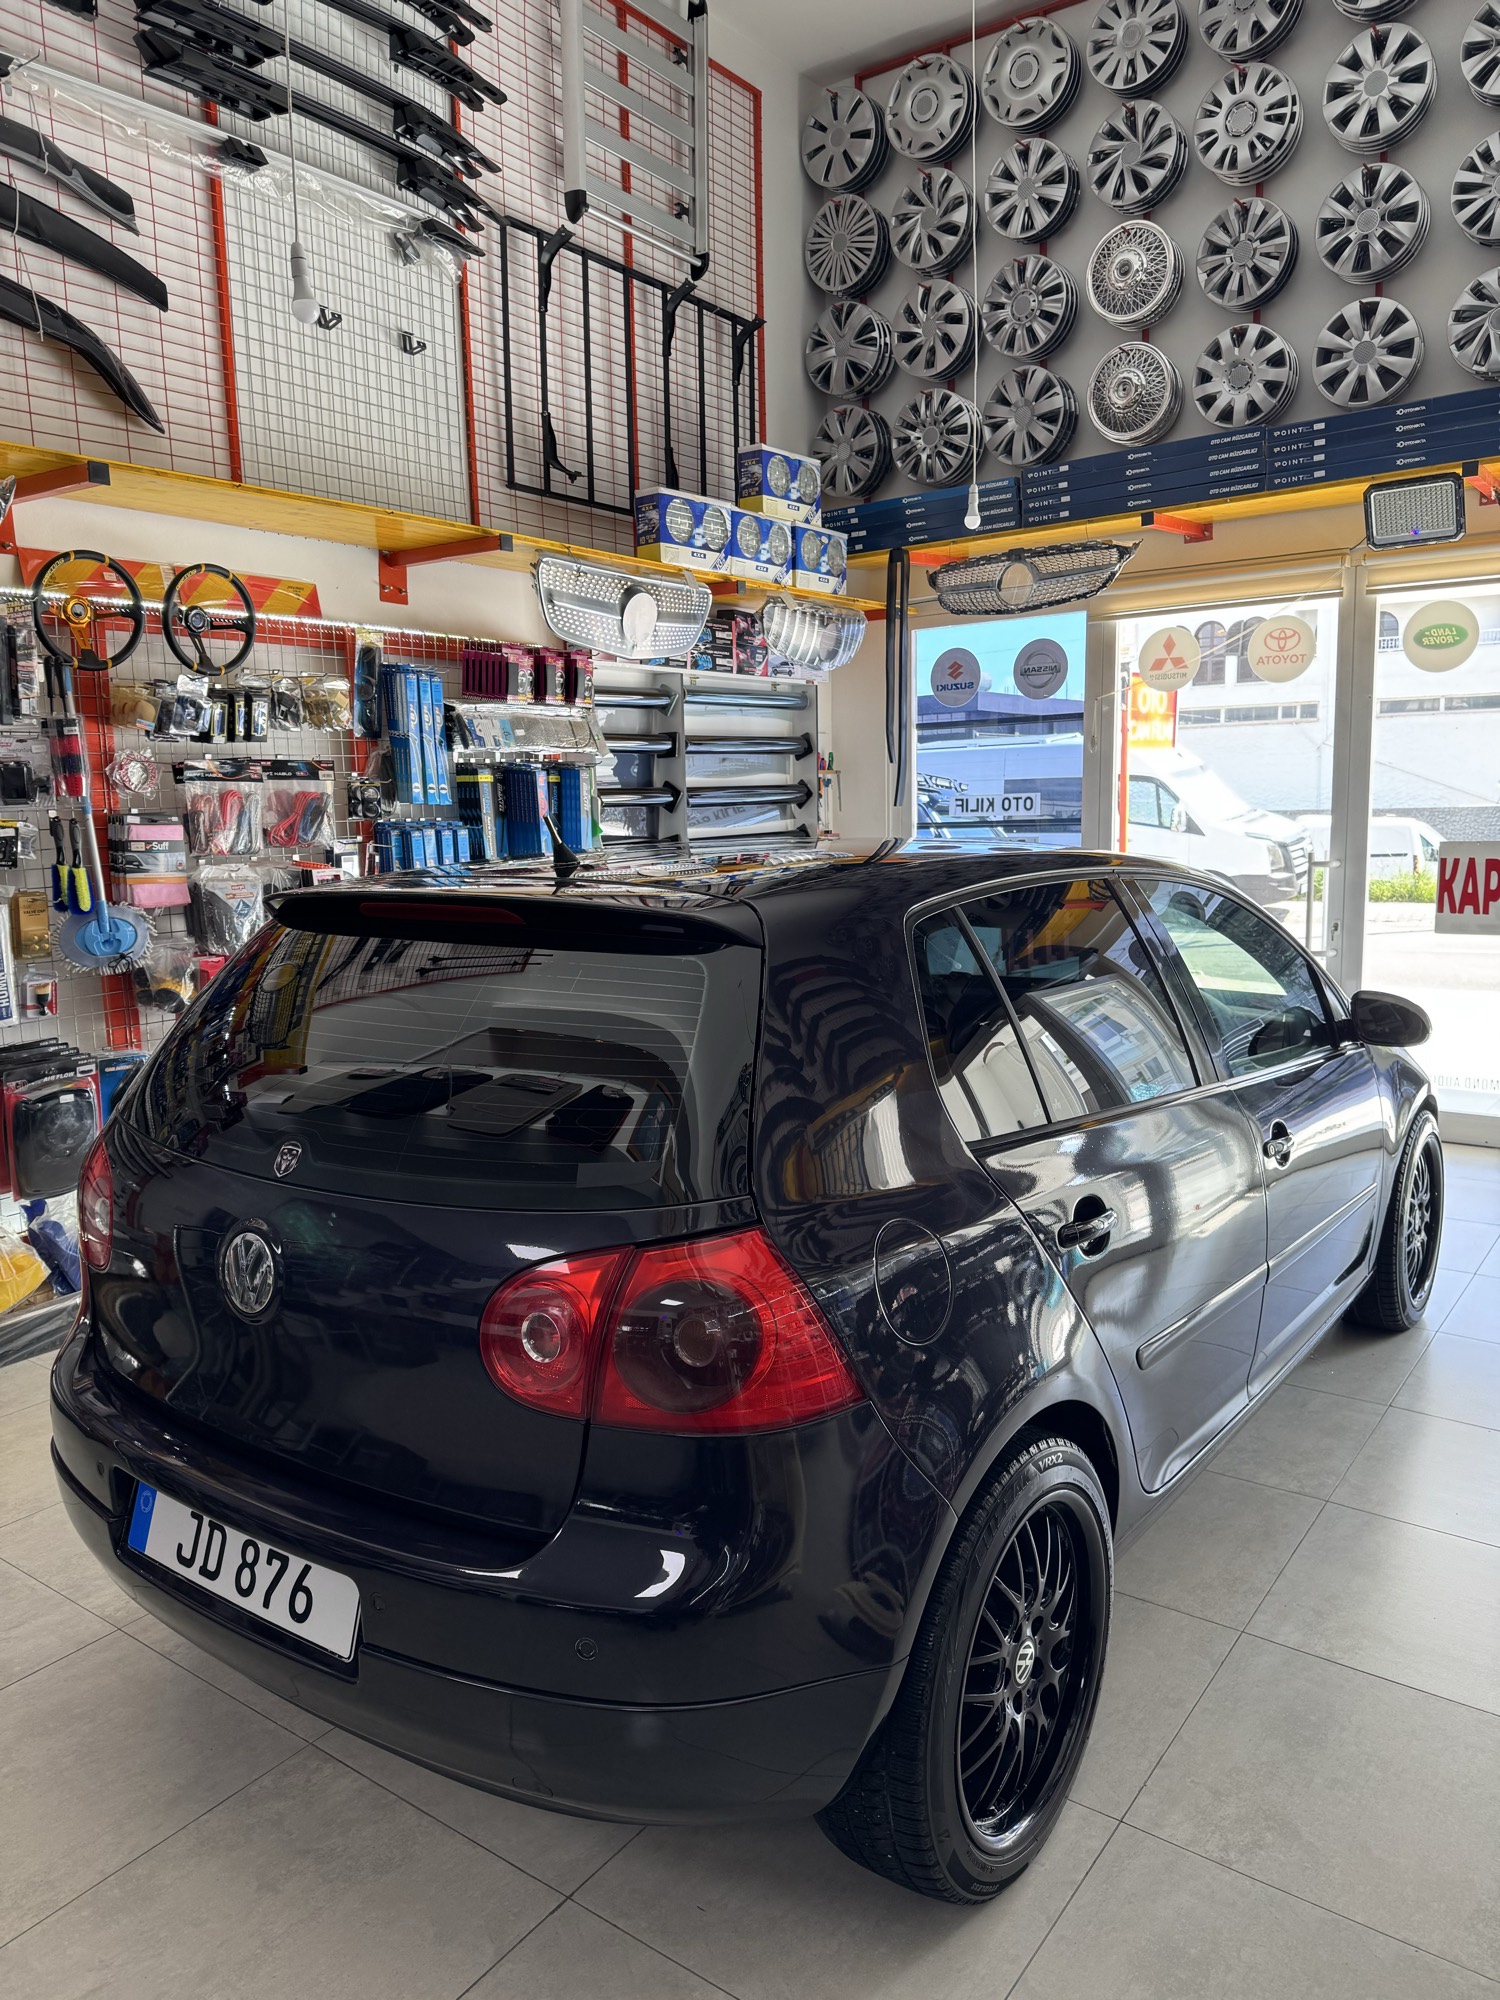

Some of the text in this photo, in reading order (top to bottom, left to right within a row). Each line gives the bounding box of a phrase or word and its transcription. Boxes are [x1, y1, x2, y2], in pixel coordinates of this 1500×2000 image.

[1273, 427, 1302, 437] POINT
[1273, 443, 1302, 453] POINT
[1274, 458, 1303, 467] POINT
[1028, 469, 1052, 479] POINT
[1274, 475, 1303, 484] POINT
[1027, 485, 1052, 494] POINT
[1028, 500, 1053, 508] POINT
[1028, 514, 1053, 523] POINT
[824, 521, 844, 529] POINT
[152, 841, 169, 850] Suff
[1437, 857, 1500, 915] KAP
[43, 1071, 75, 1082] AIR FLOW
[1038, 1452, 1064, 1471] VRX2
[176, 1510, 313, 1624] JD 876
